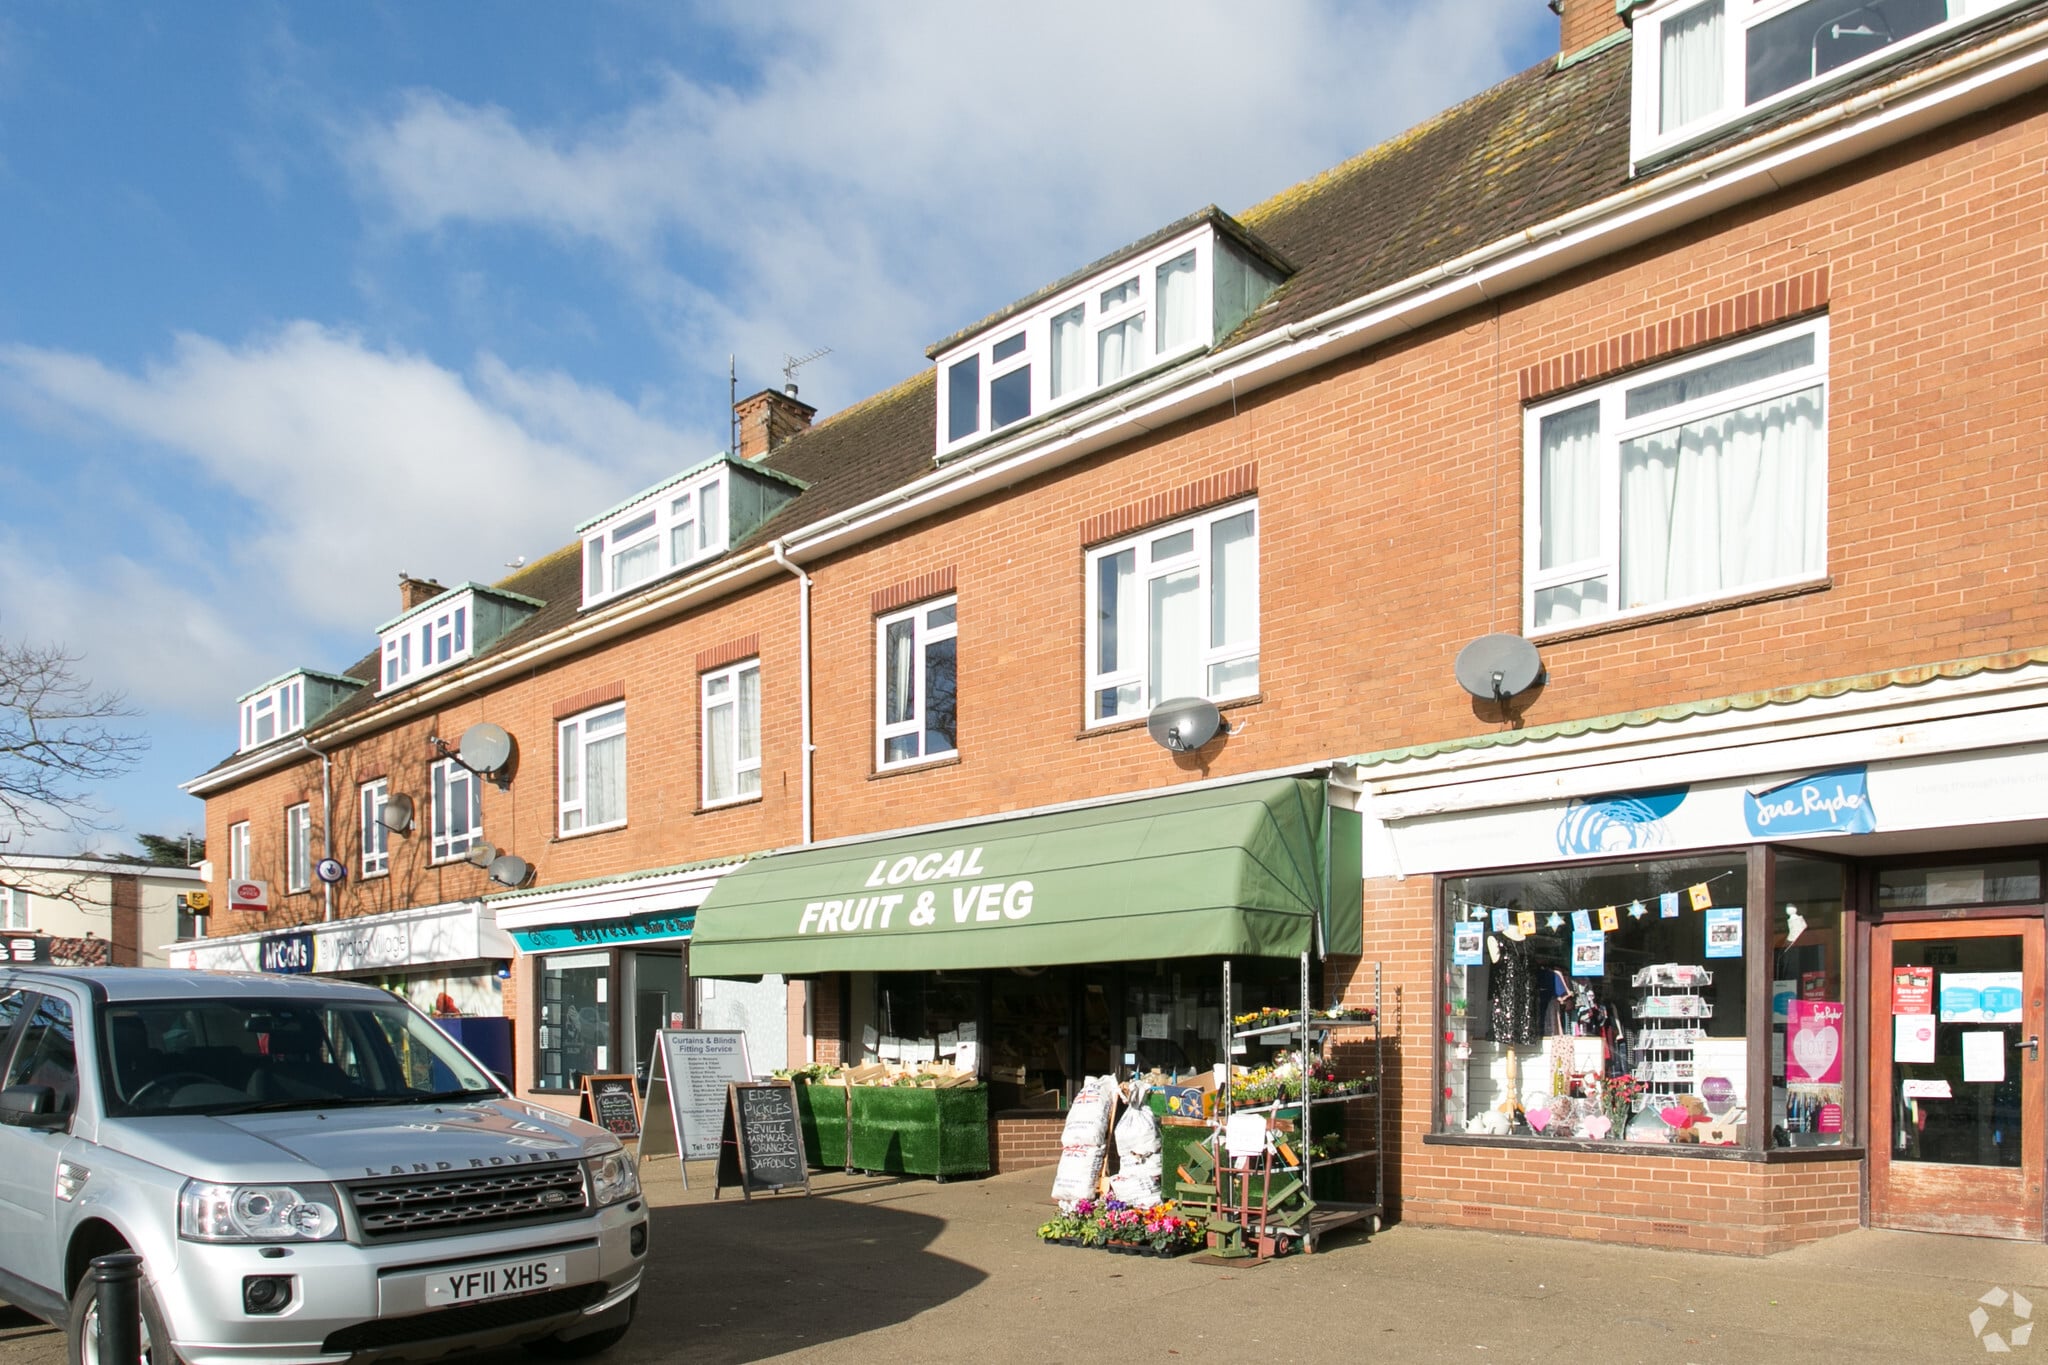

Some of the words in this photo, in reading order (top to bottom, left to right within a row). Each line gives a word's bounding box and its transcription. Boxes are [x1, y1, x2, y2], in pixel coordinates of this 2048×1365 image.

[1755, 797, 1802, 827] Sue
[864, 847, 984, 887] LOCAL
[798, 894, 903, 934] FRUIT
[908, 890, 936, 927] &
[953, 880, 1034, 923] VEG
[672, 1036, 704, 1045] Curtains
[713, 1036, 737, 1044] Blinds
[679, 1045, 704, 1054] Fitting
[705, 1045, 733, 1053] Service
[749, 1089, 782, 1101] EDES
[744, 1102, 792, 1116] PICKLES
[745, 1122, 786, 1135] SEVILLE
[691, 1143, 705, 1151] Tel:
[750, 1143, 797, 1154] ORANGES
[365, 1161, 453, 1177] LAND
[468, 1151, 560, 1168] ROVER
[751, 1157, 797, 1170] DAFFODILS
[503, 1262, 548, 1292] XHS
